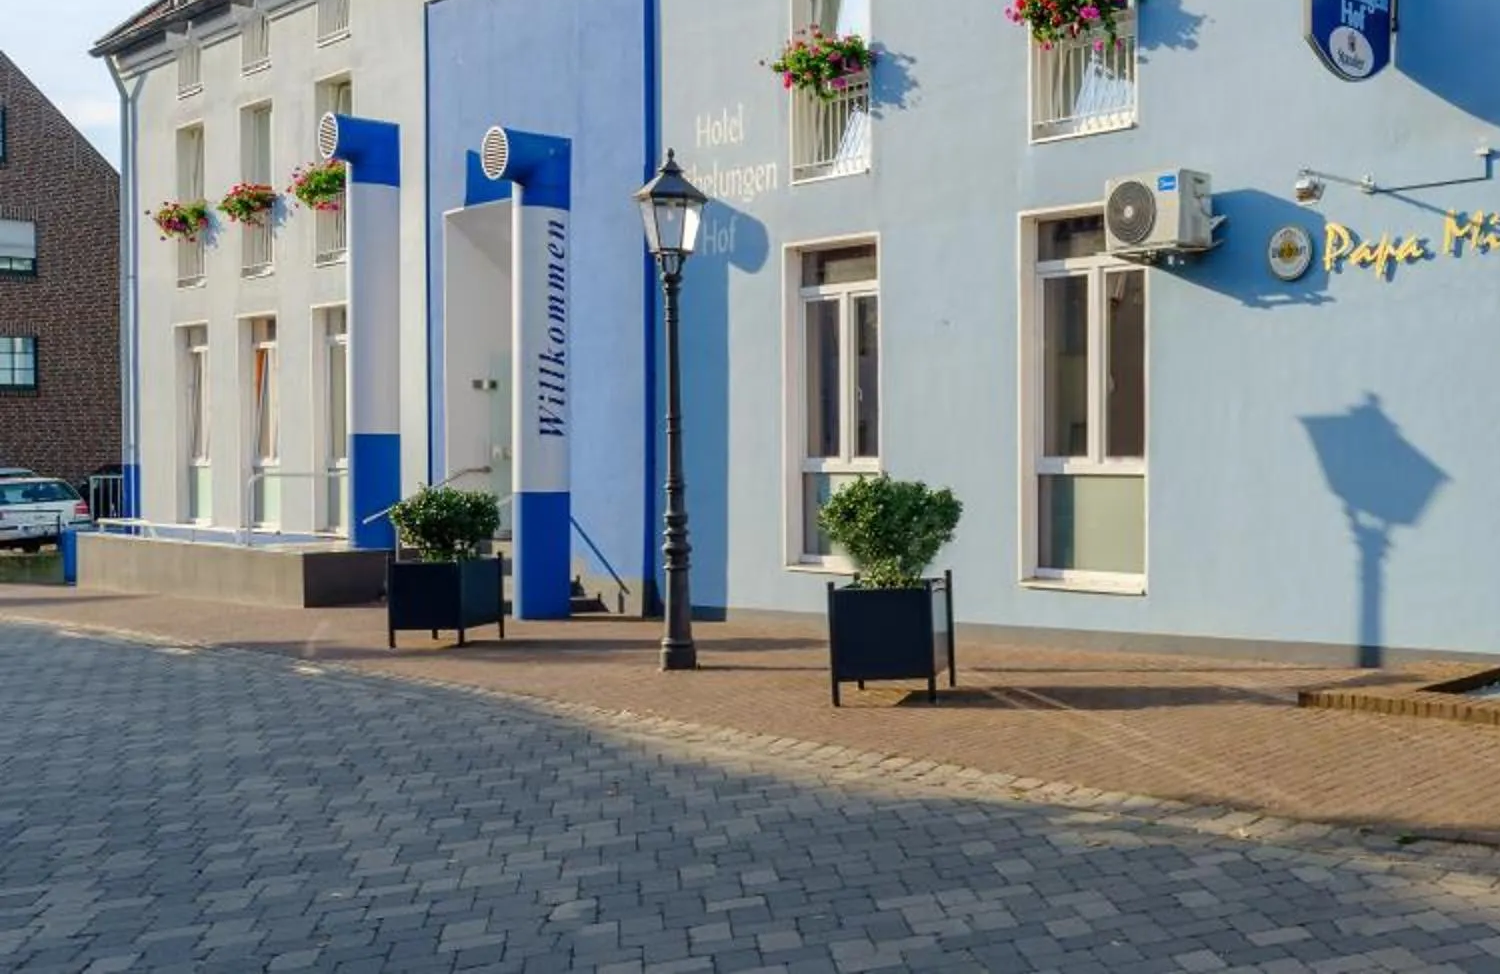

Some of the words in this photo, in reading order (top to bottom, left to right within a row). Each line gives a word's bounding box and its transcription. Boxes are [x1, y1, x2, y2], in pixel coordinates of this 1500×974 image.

[695, 102, 745, 147] Hotel
[702, 215, 738, 256] Hof
[1323, 221, 1424, 280] Papa
[538, 219, 566, 438] Willkommen
